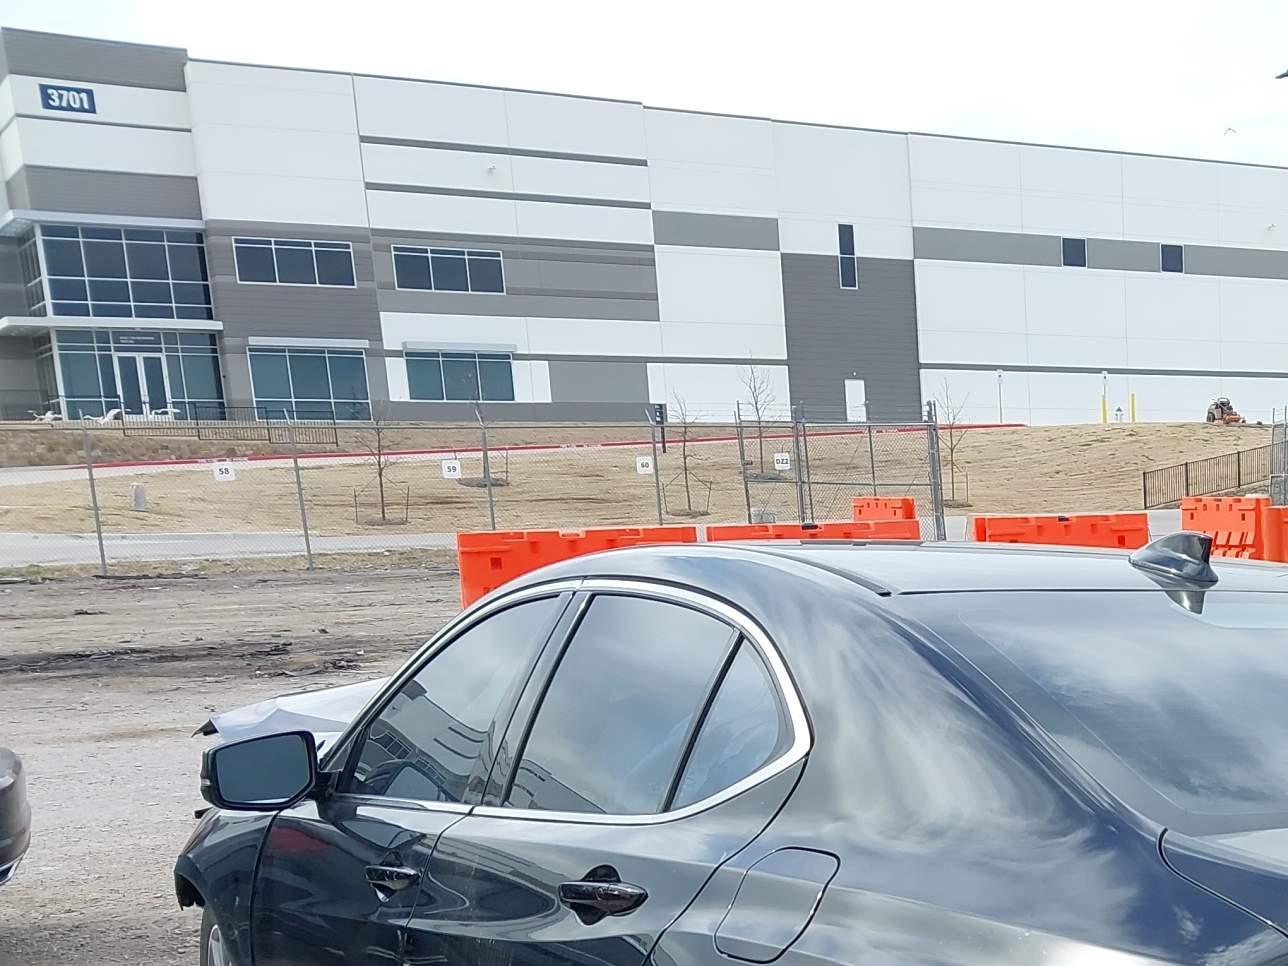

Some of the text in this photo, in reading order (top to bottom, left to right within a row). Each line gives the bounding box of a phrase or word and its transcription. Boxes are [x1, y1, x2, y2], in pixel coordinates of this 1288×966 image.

[47, 89, 89, 109] 3701
[447, 465, 457, 473] 59
[640, 461, 650, 469] 60
[218, 467, 230, 475] 58
